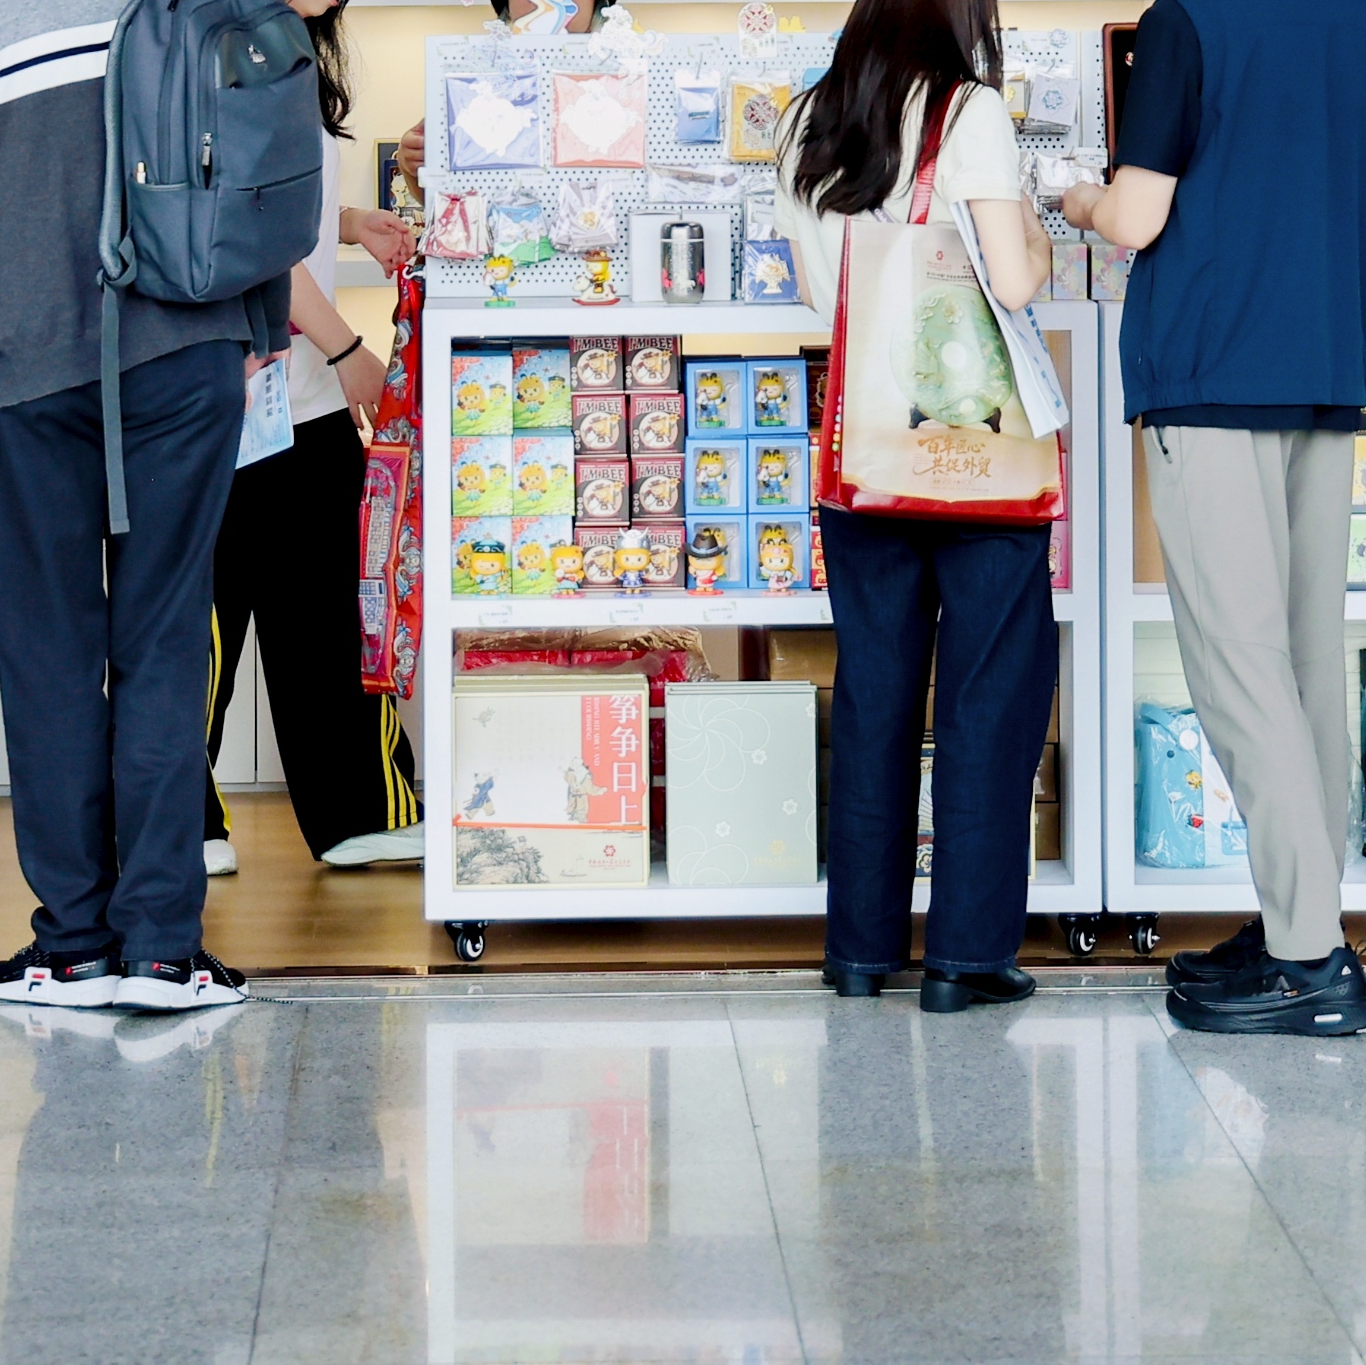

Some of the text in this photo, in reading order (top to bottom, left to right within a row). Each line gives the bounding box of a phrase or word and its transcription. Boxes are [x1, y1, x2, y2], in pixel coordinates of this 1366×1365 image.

[917, 434, 986, 457] 百年匠心
[609, 694, 640, 825] 筝争日上
